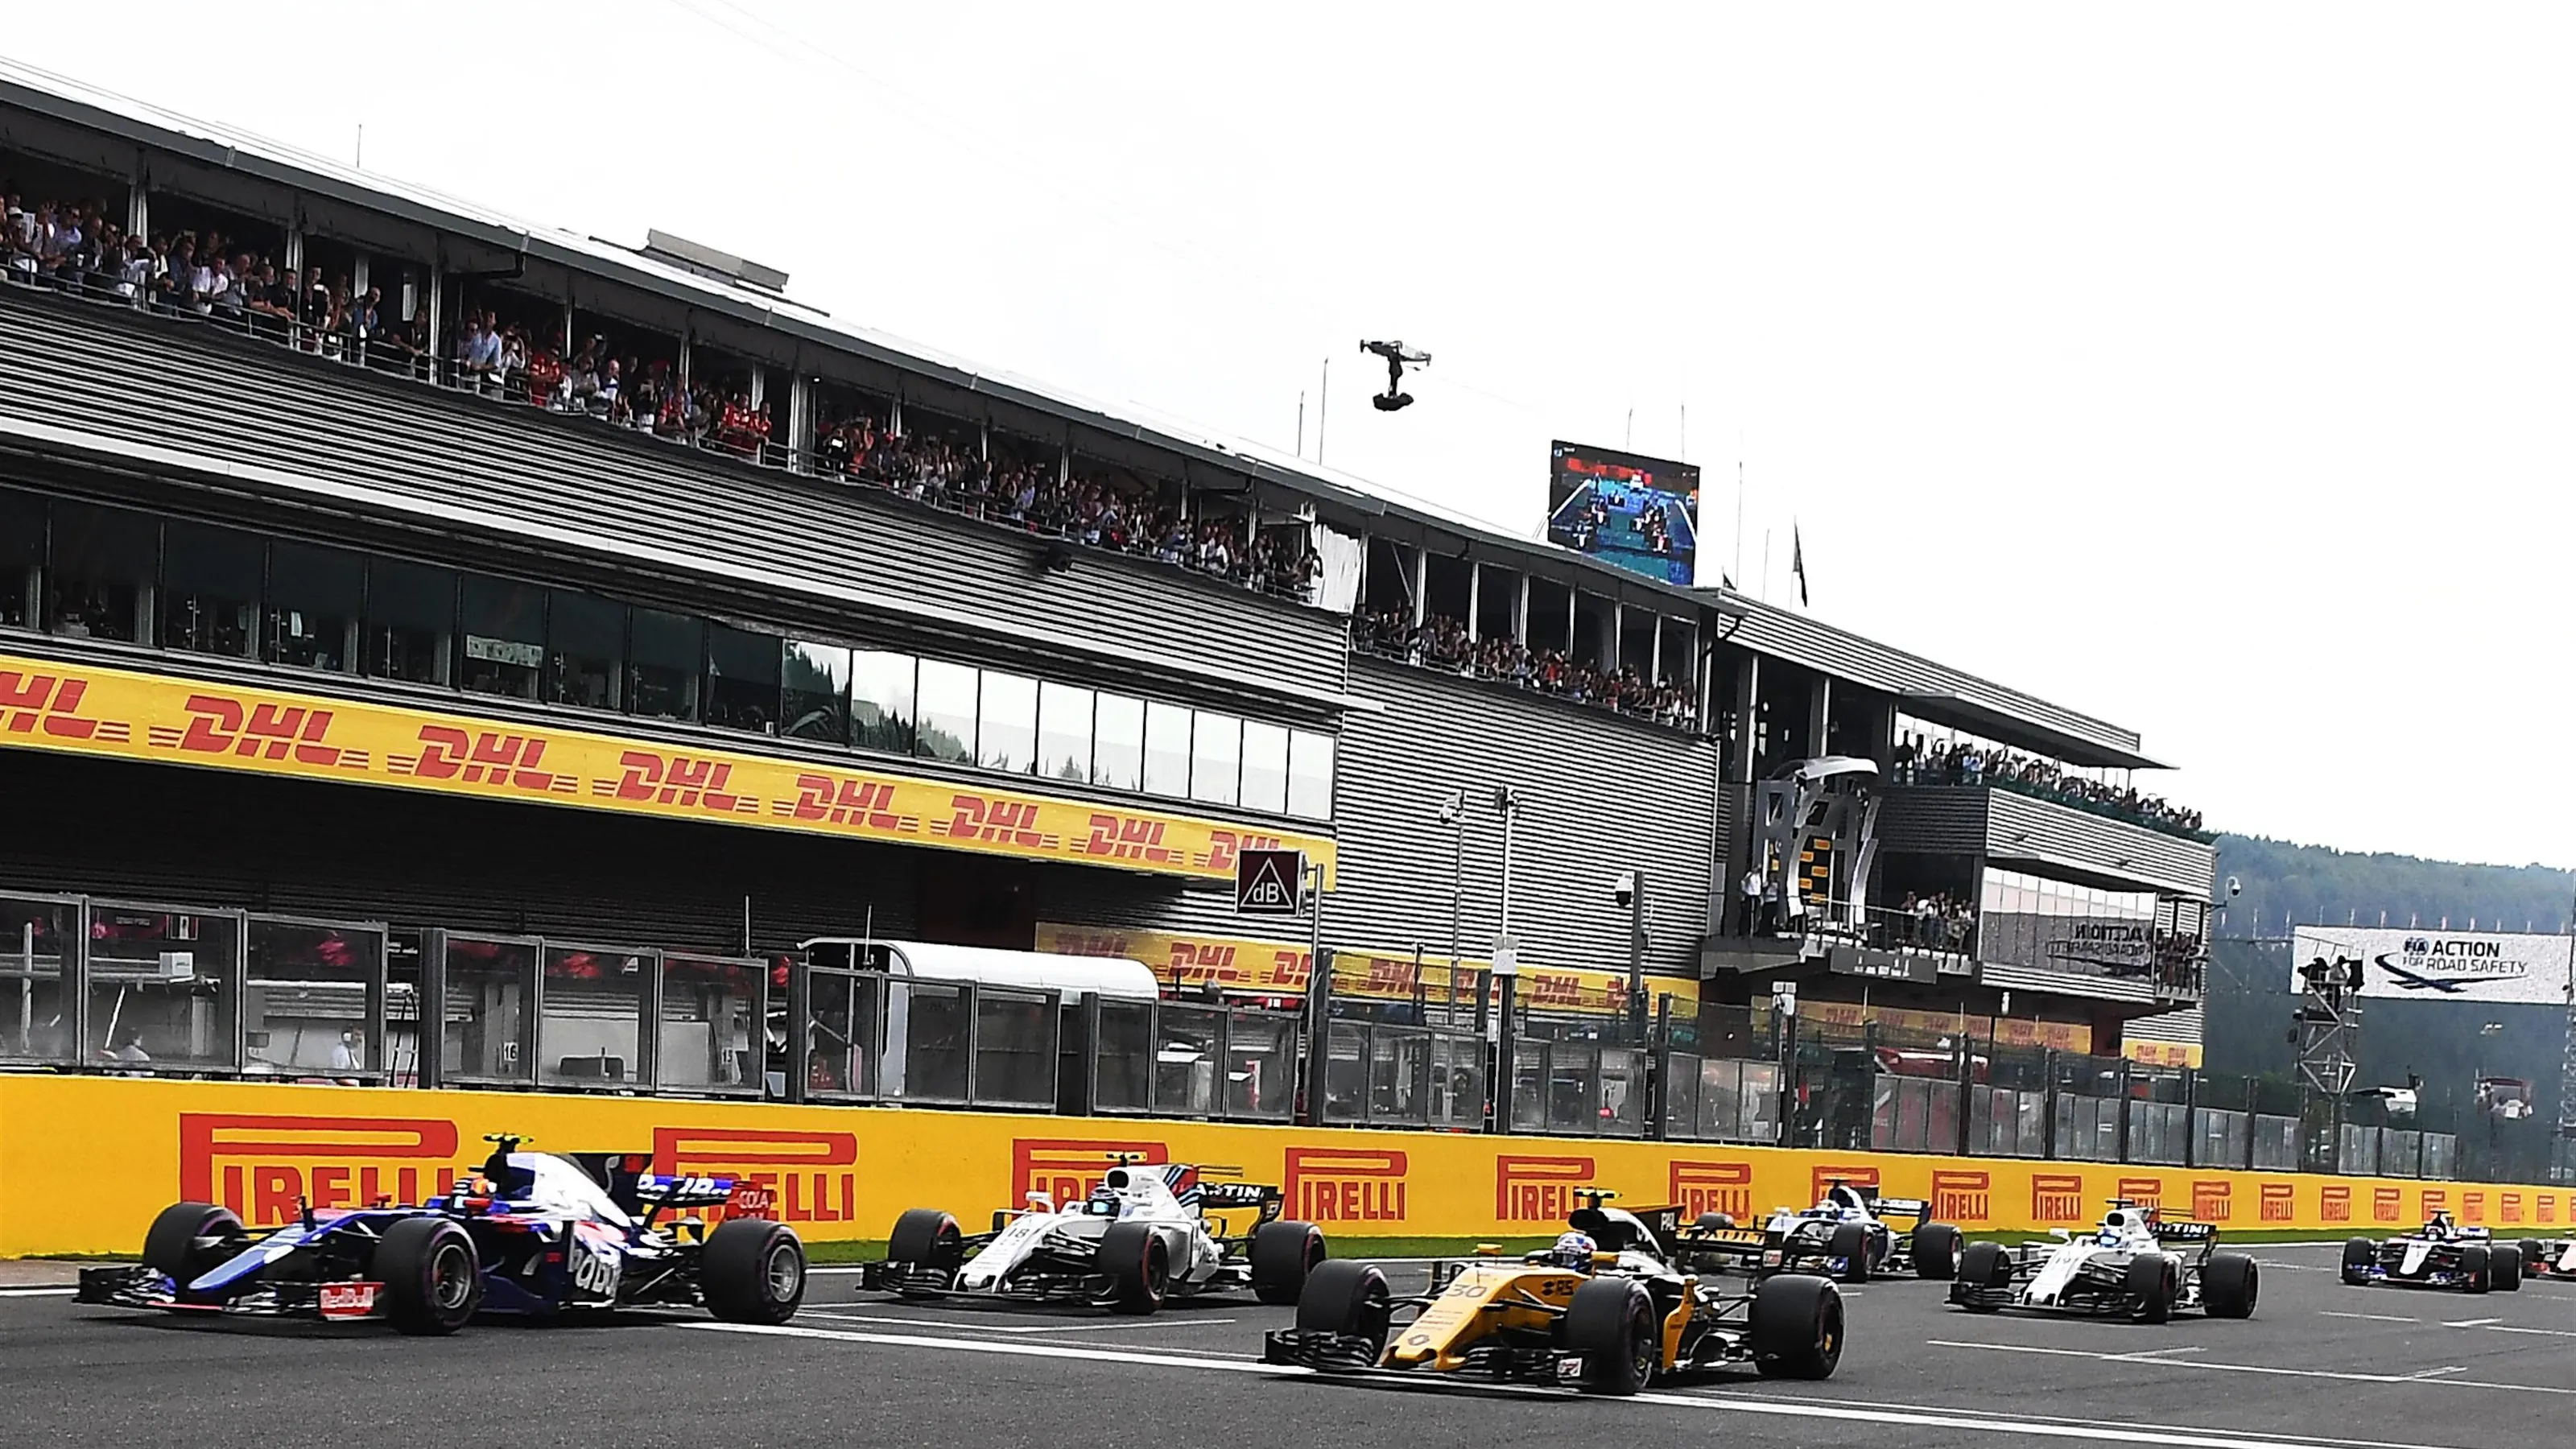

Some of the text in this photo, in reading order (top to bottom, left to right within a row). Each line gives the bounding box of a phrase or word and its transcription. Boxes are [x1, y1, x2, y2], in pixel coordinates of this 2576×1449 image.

[0, 671, 98, 739] HL
[180, 695, 340, 766] DHL
[413, 724, 553, 791] DHL
[616, 750, 737, 812] DHL
[793, 773, 900, 831] DHL
[948, 794, 1043, 848] DHL
[1086, 814, 1170, 862] DHL
[1253, 882, 1279, 902] dB
[1166, 942, 1239, 983] DHL
[1272, 952, 1314, 985] DH
[2426, 958, 2467, 971] ROAD
[2471, 960, 2527, 973] SAFETY
[2432, 940, 2500, 957] ACTION
[1533, 974, 1580, 1005] DHL
[739, 1191, 769, 1208] COLA
[1283, 1147, 1407, 1223] PIRELLI
[1496, 1155, 1596, 1220] PIREL
[1670, 1160, 1751, 1220] PIRELLI
[1932, 1170, 1989, 1220] PIRELLI
[2032, 1174, 2082, 1220] PIRELLI
[1446, 1283, 1487, 1297] 30
